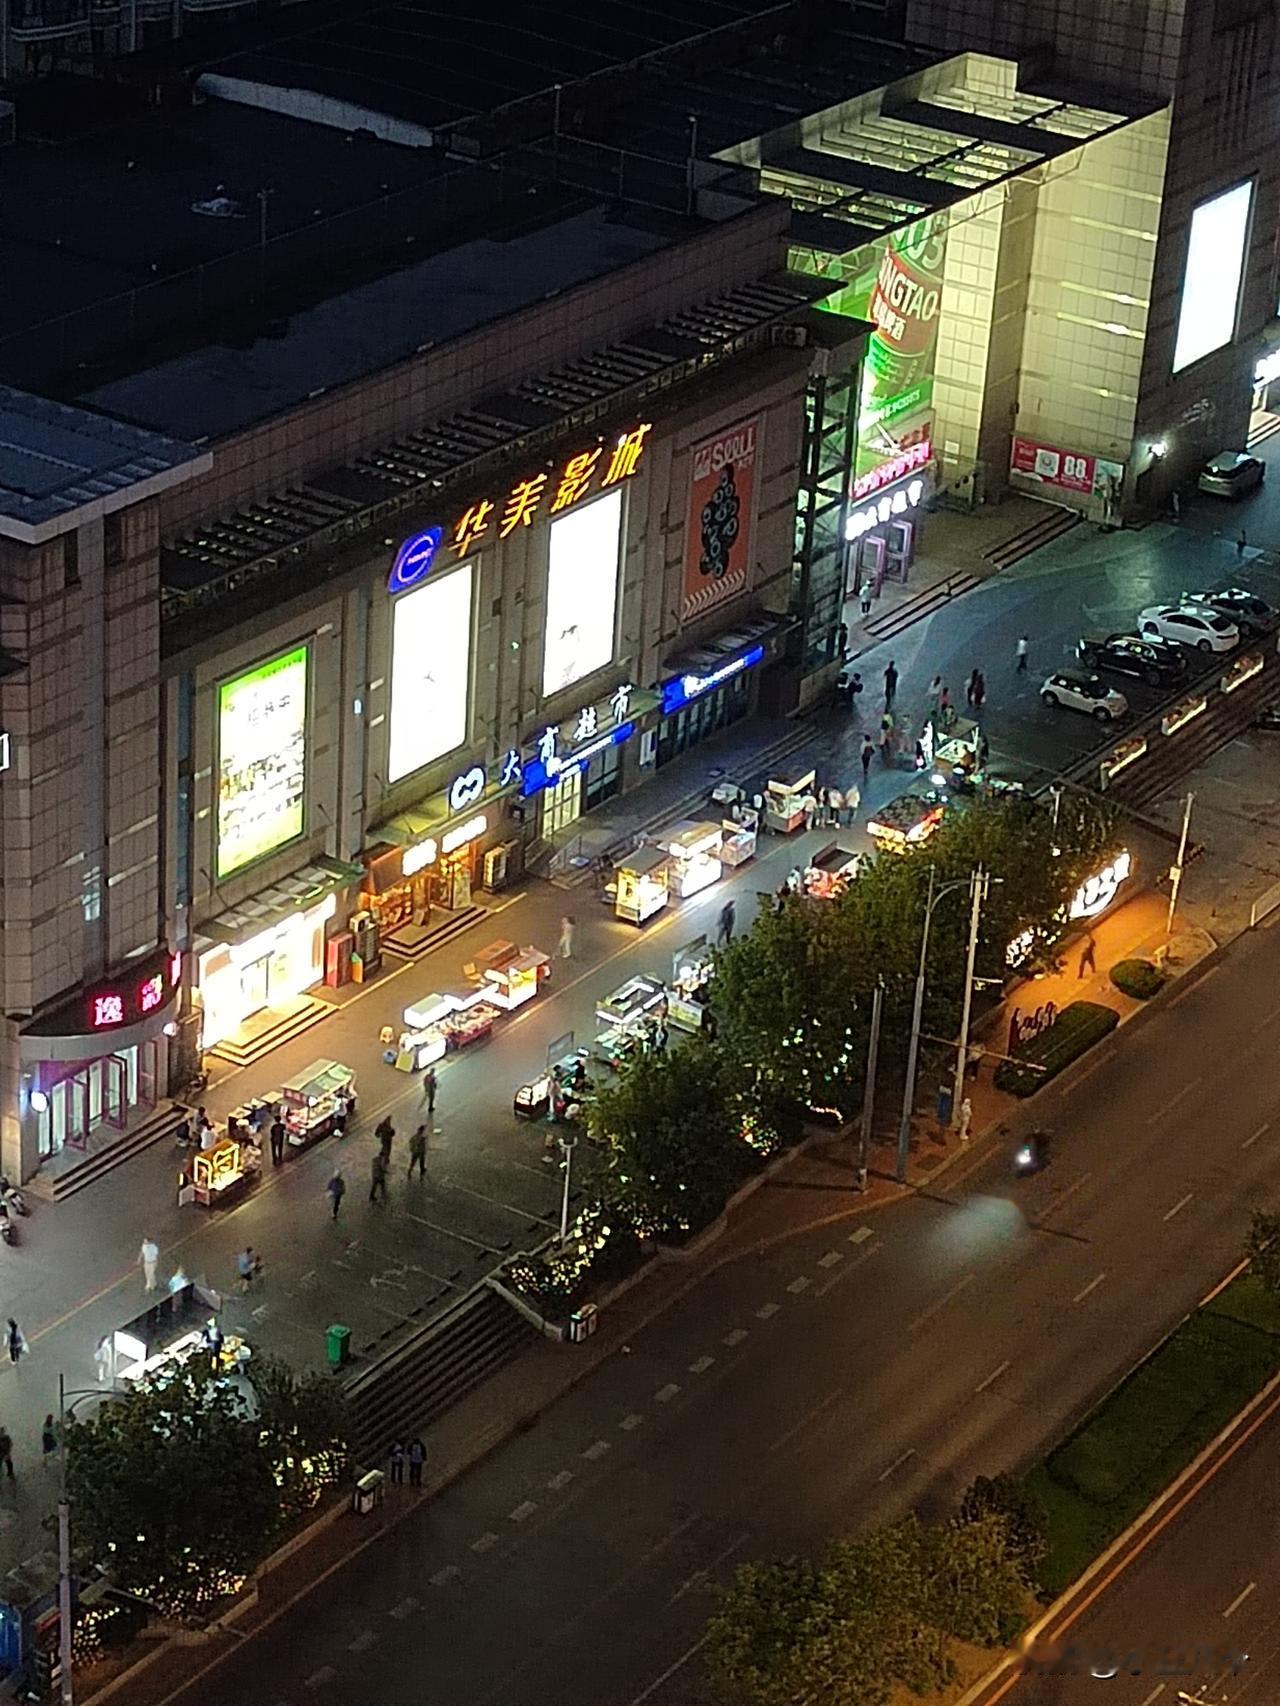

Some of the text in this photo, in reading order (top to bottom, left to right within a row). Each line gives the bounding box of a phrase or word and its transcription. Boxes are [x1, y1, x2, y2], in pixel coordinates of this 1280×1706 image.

[448, 423, 652, 558] 华美影城
[1064, 455, 1087, 479] 88
